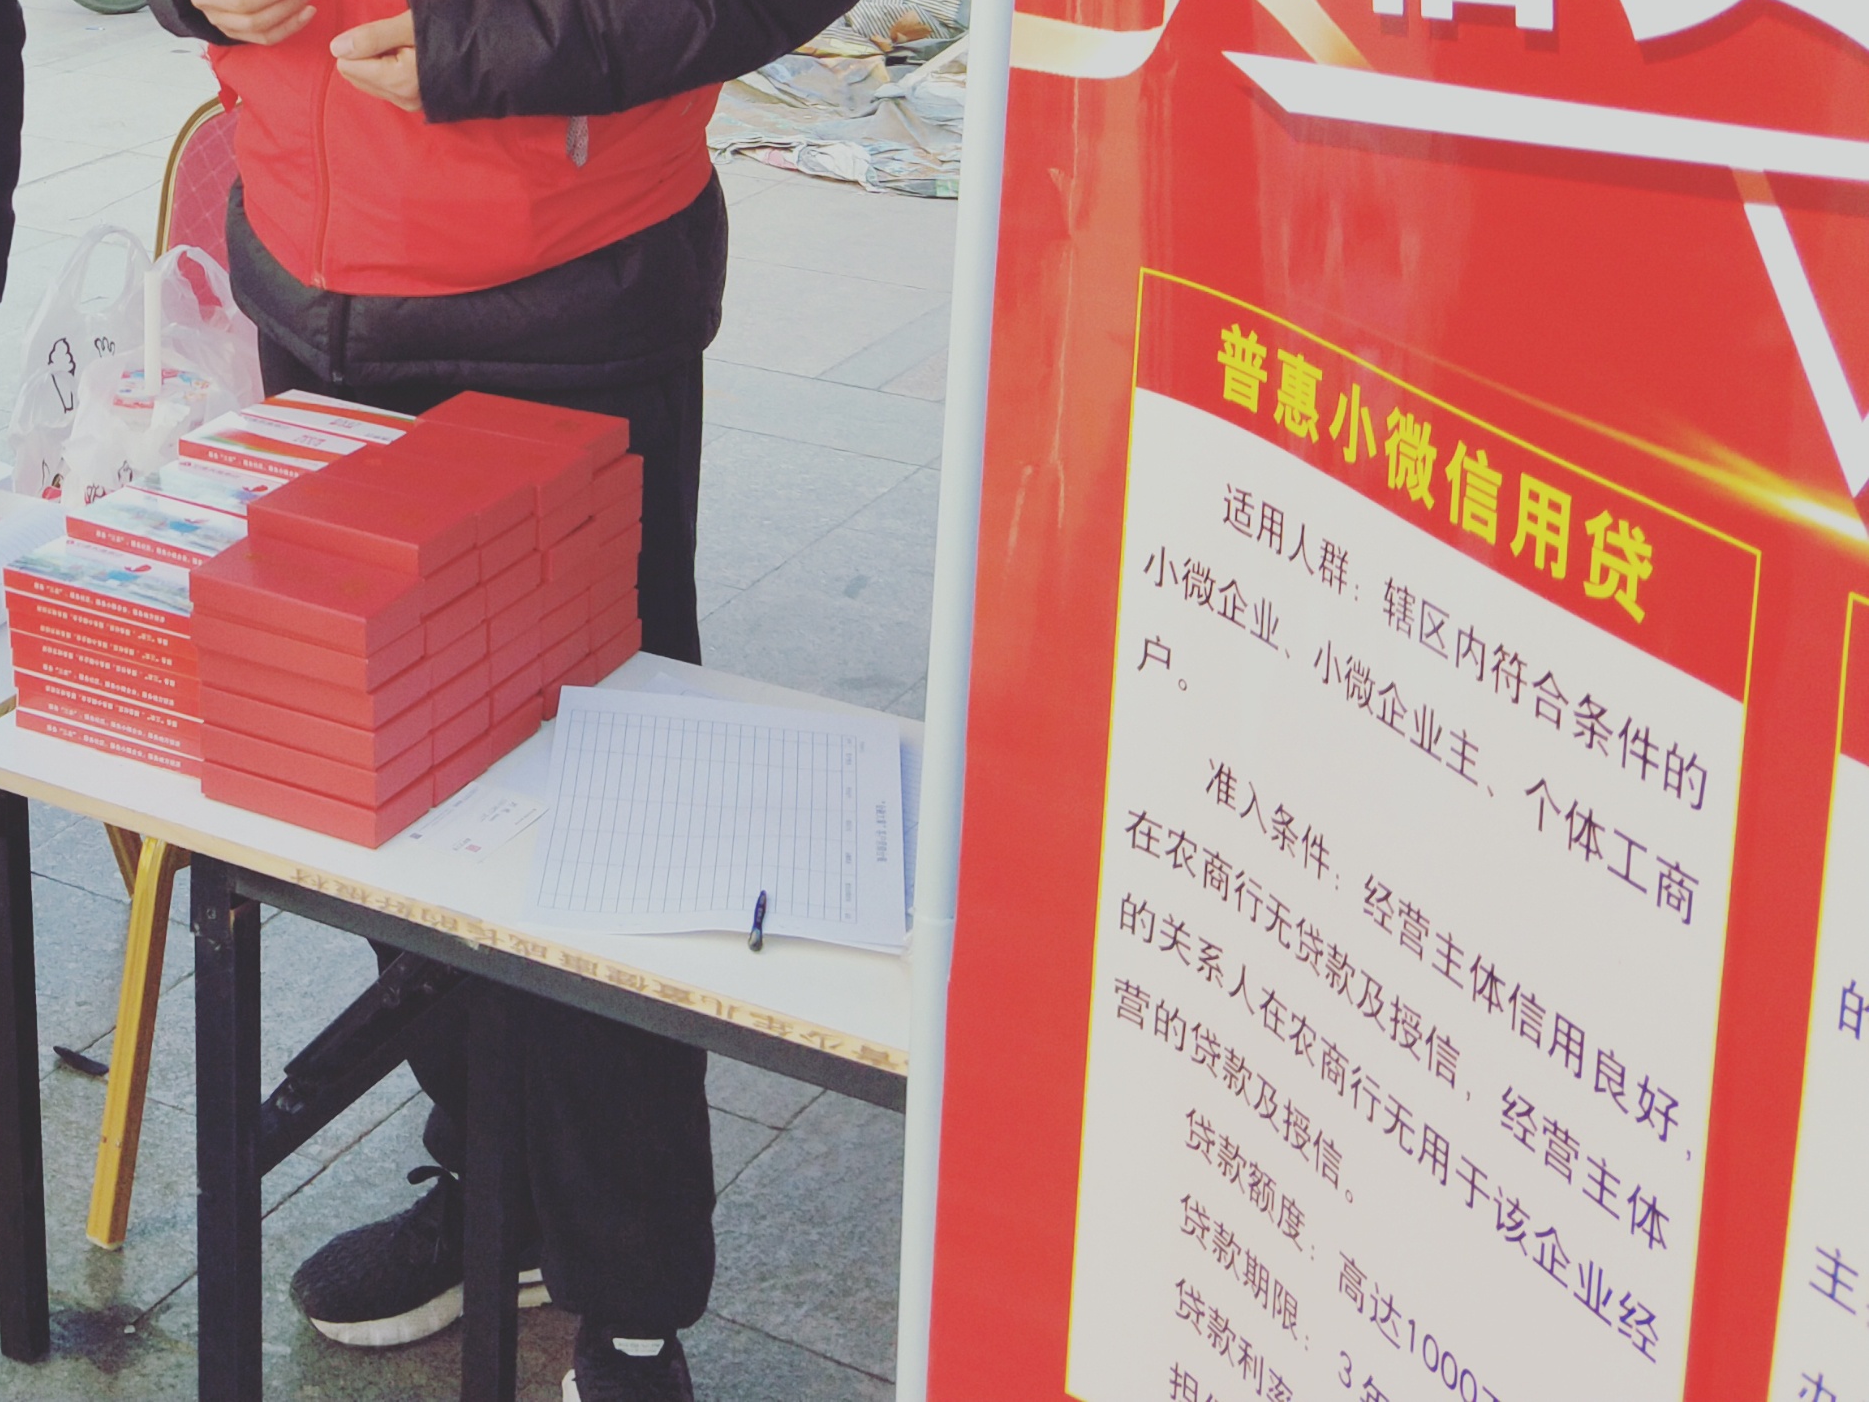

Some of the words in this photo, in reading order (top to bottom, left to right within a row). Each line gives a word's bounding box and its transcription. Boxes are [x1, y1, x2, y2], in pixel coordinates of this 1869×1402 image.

[1216, 323, 1655, 623] 普惠小微信用贷
[1119, 892, 1658, 1365] 的关系人在农商行无用于该企业经
